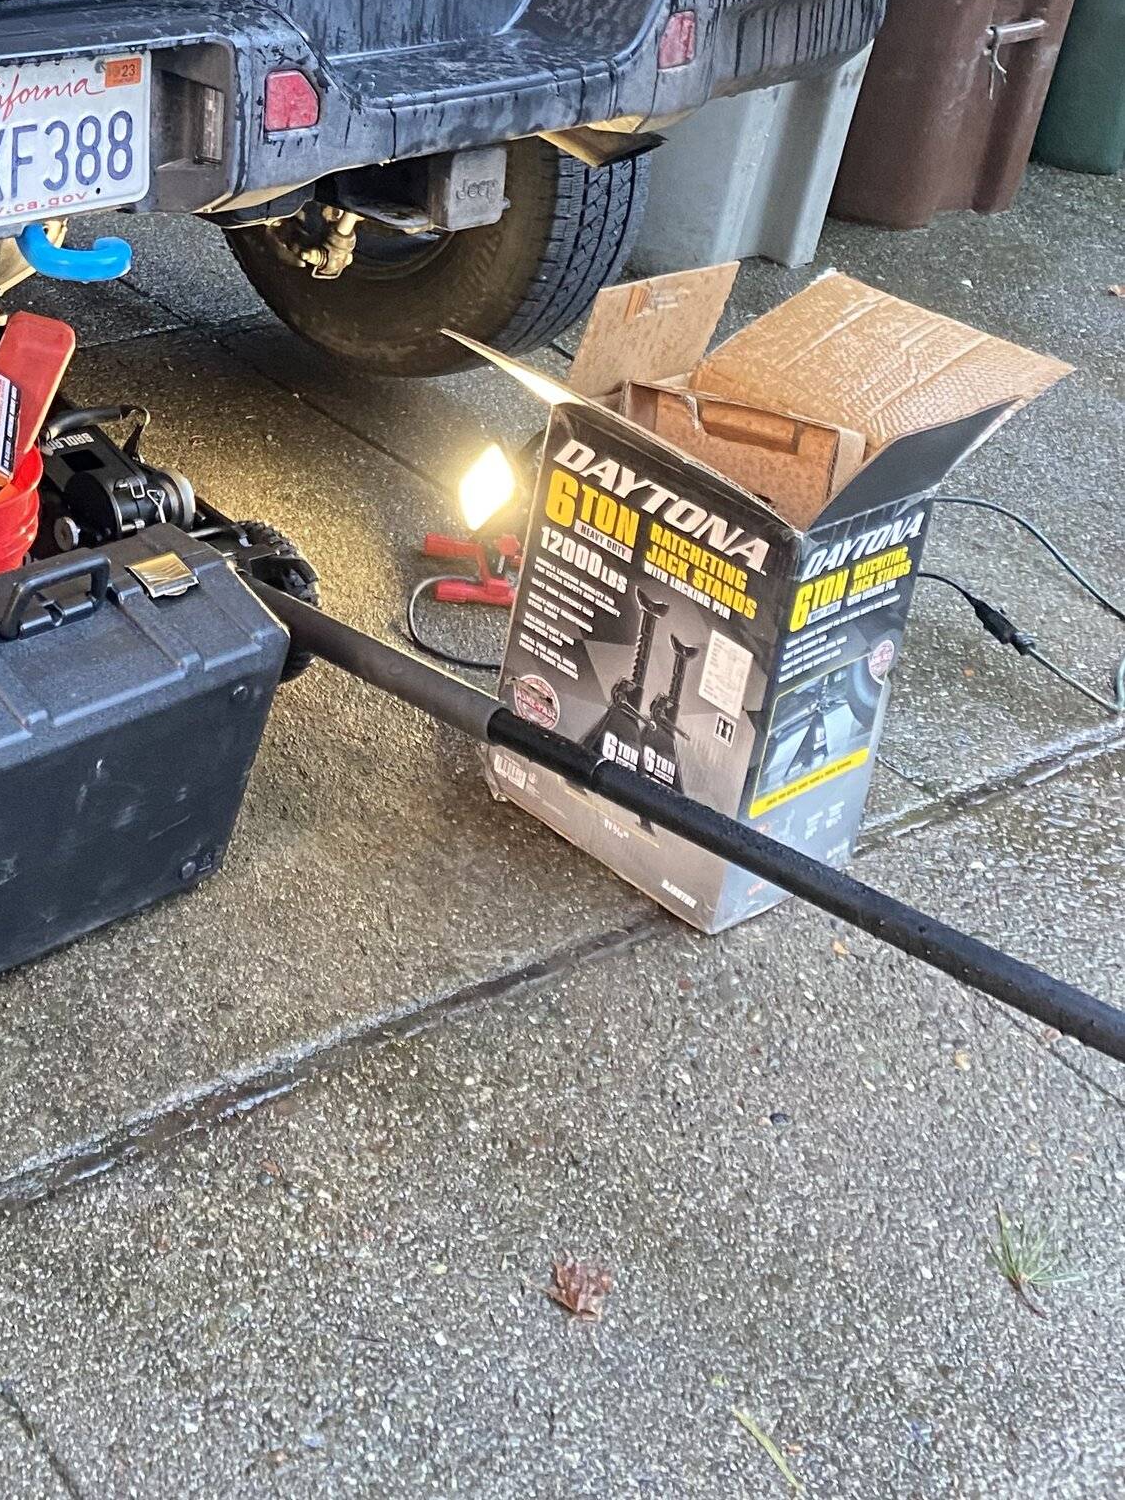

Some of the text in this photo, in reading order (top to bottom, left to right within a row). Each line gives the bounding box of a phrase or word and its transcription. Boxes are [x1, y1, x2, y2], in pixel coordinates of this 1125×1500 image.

[122, 64, 135, 77] 23
[456, 179, 499, 204] Jeep
[46, 432, 95, 450] BADLAN
[545, 469, 641, 549] 6 TON
[553, 439, 770, 575] DAYTONA
[540, 526, 628, 594] 12000 LBS
[580, 524, 627, 557] HEAVY DUTY
[650, 520, 749, 592] RATCHETING
[800, 512, 925, 583] DAYTONA
[643, 560, 669, 584] WITH
[712, 600, 732, 620] PIN
[645, 545, 691, 581] JACK
[692, 569, 758, 620] STANDS
[789, 583, 814, 632] 6
[812, 569, 850, 611] TON
[602, 731, 619, 761] 6
[617, 740, 639, 766] TON
[643, 746, 656, 773] 6
[655, 754, 675, 778] TON
